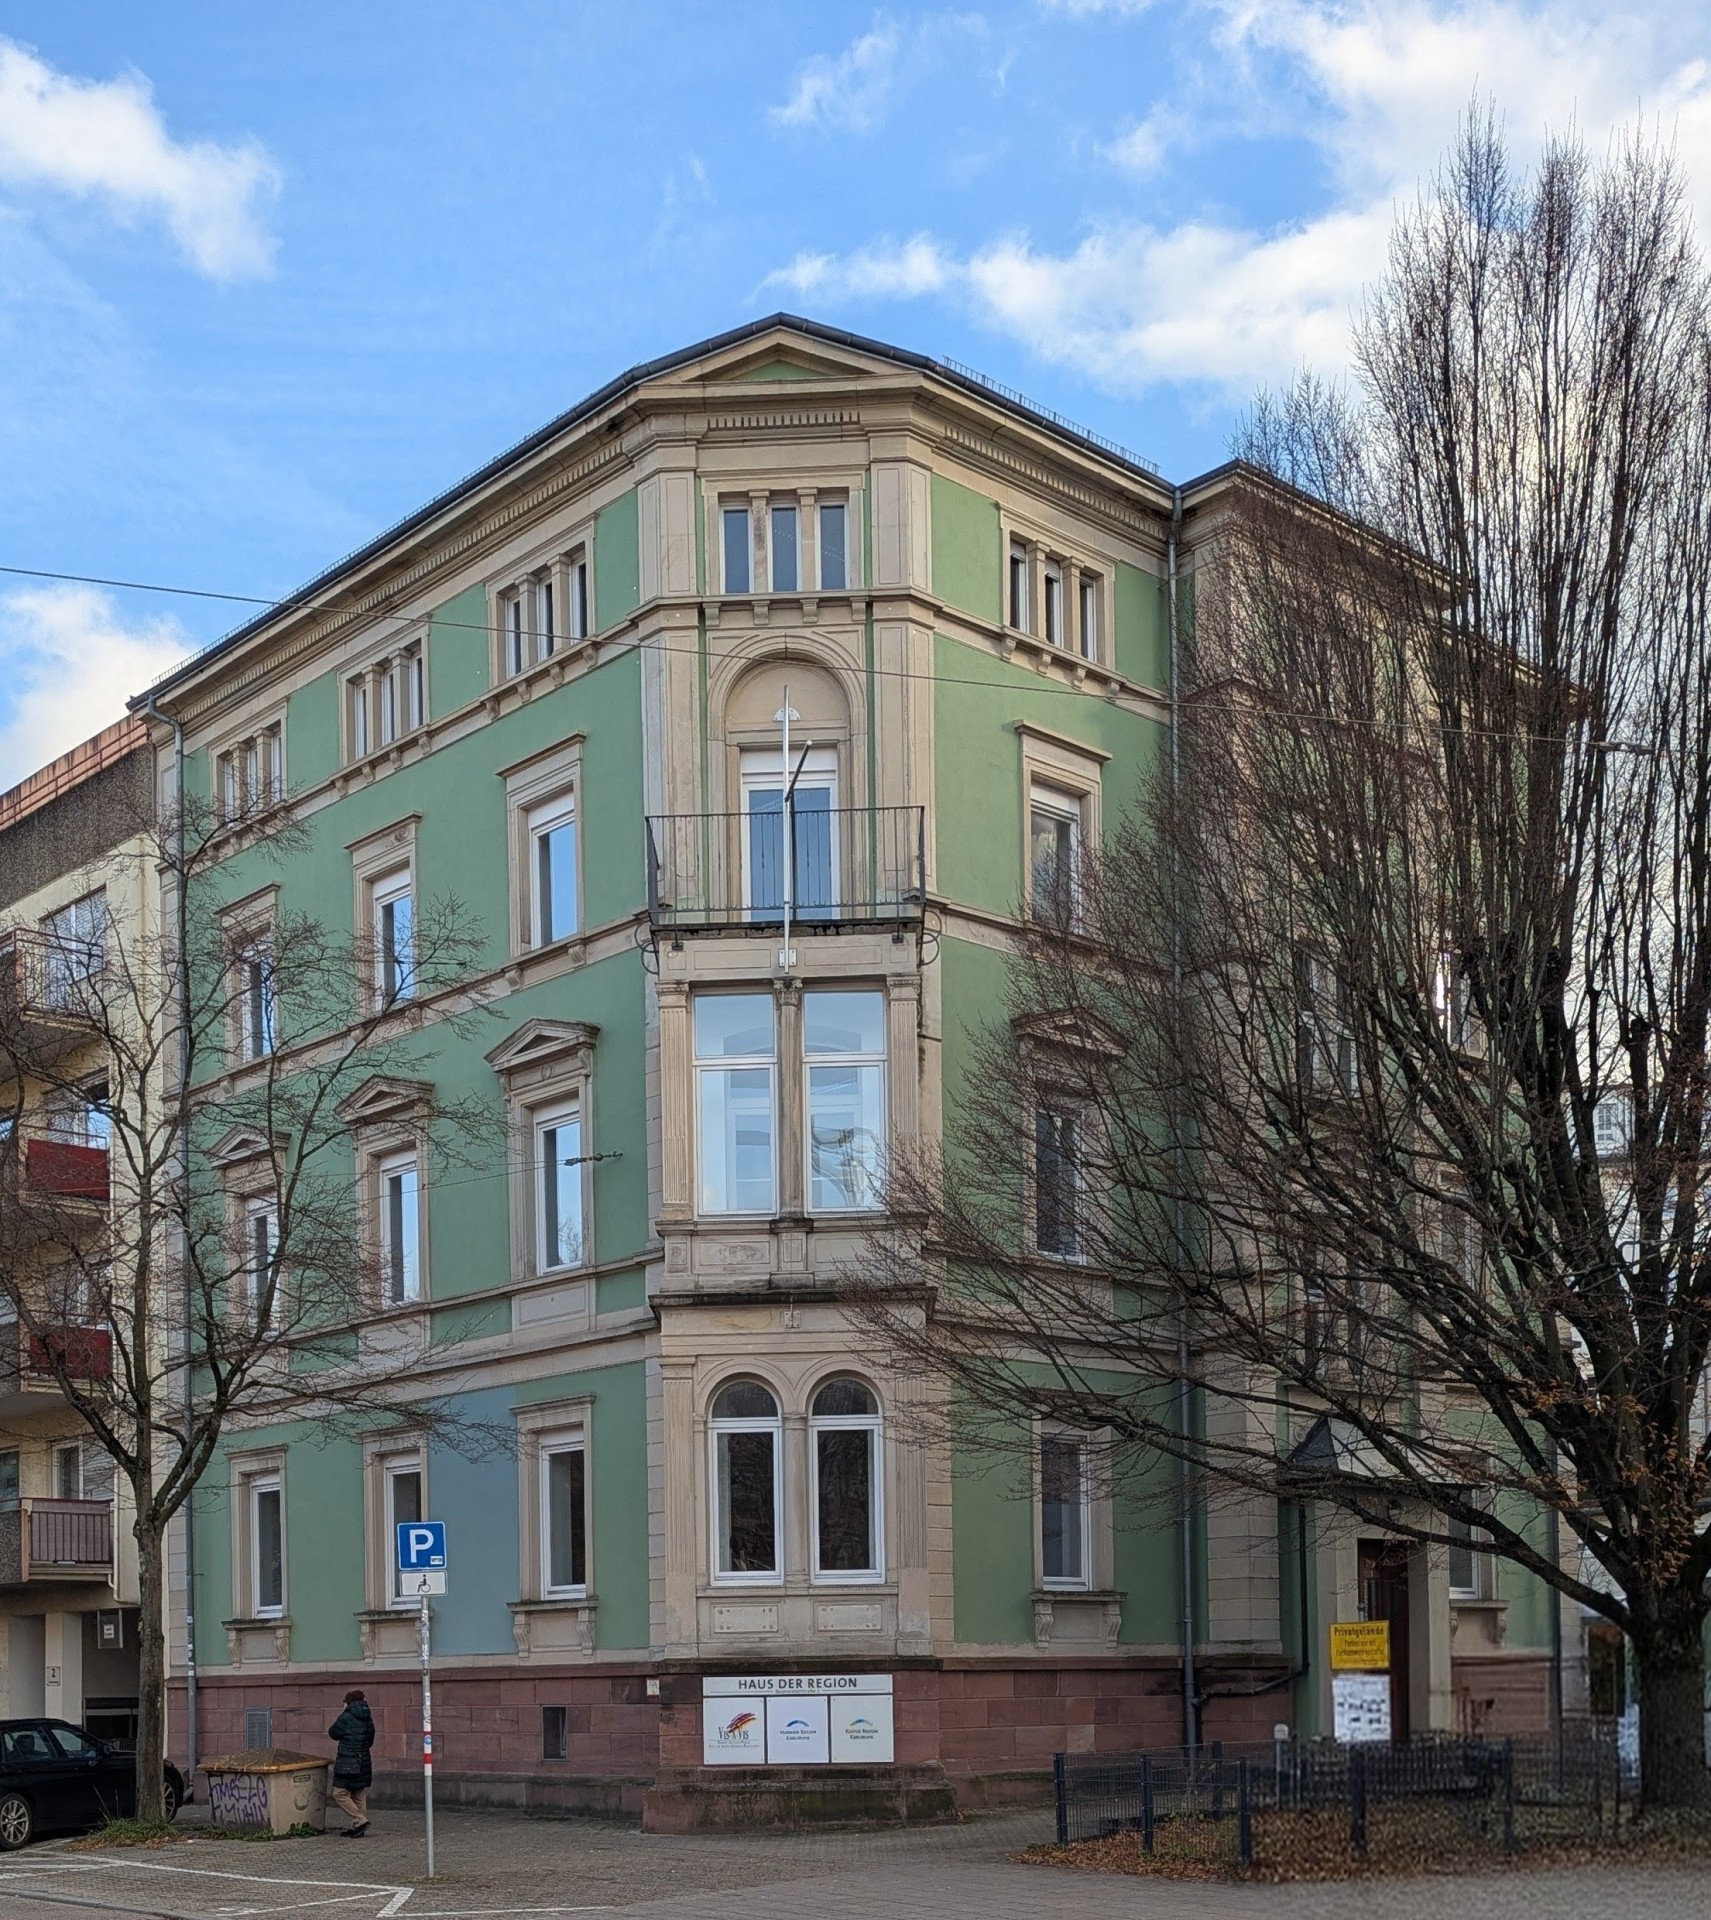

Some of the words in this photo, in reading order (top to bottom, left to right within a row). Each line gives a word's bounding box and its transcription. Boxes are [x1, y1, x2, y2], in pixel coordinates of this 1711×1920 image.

[409, 1529, 434, 1563] P
[51, 1668, 56, 1678] 2
[738, 1679, 774, 1689] HAUS
[778, 1679, 803, 1689] DER
[808, 1678, 857, 1689] REGION
